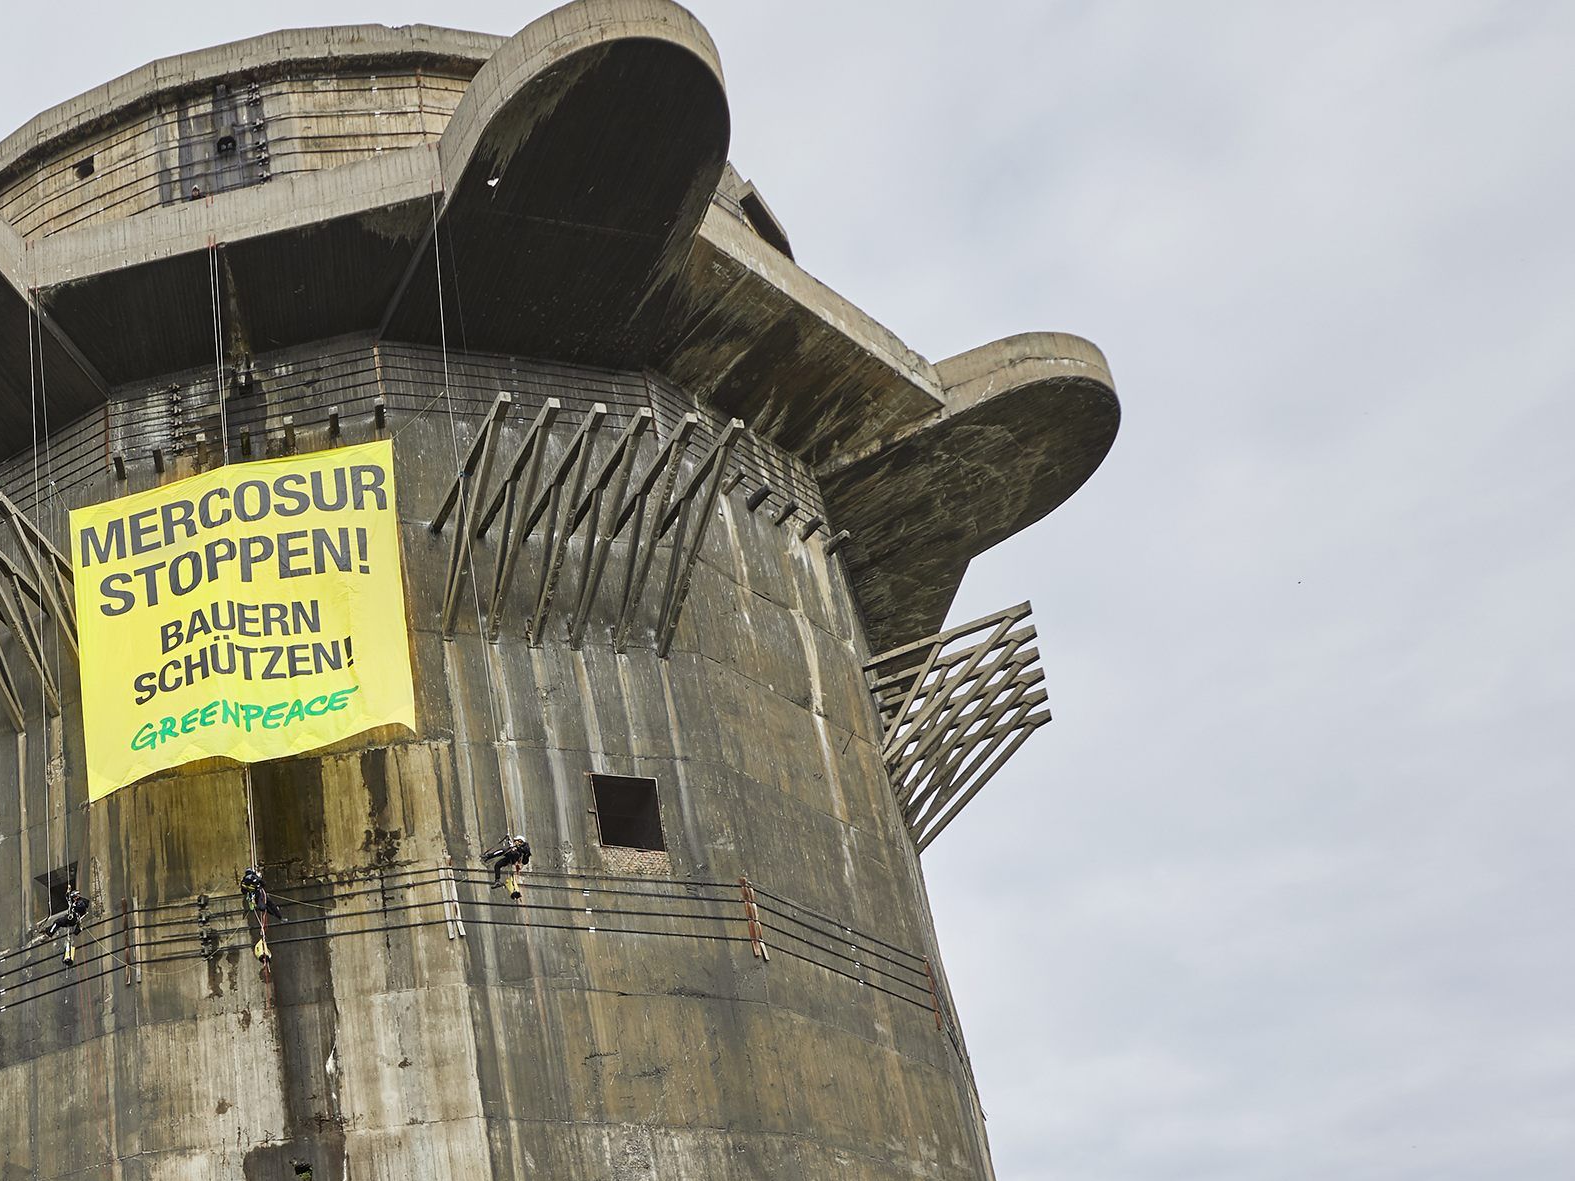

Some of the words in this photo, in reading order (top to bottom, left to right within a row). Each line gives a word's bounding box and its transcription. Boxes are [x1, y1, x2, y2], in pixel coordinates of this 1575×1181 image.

[80, 464, 388, 568] MERCOSUR
[100, 527, 370, 616] STOPPEN!
[160, 600, 320, 655] BAUERN
[133, 635, 354, 705] SCHÜTZEN!
[131, 685, 358, 751] GREENPEACE
